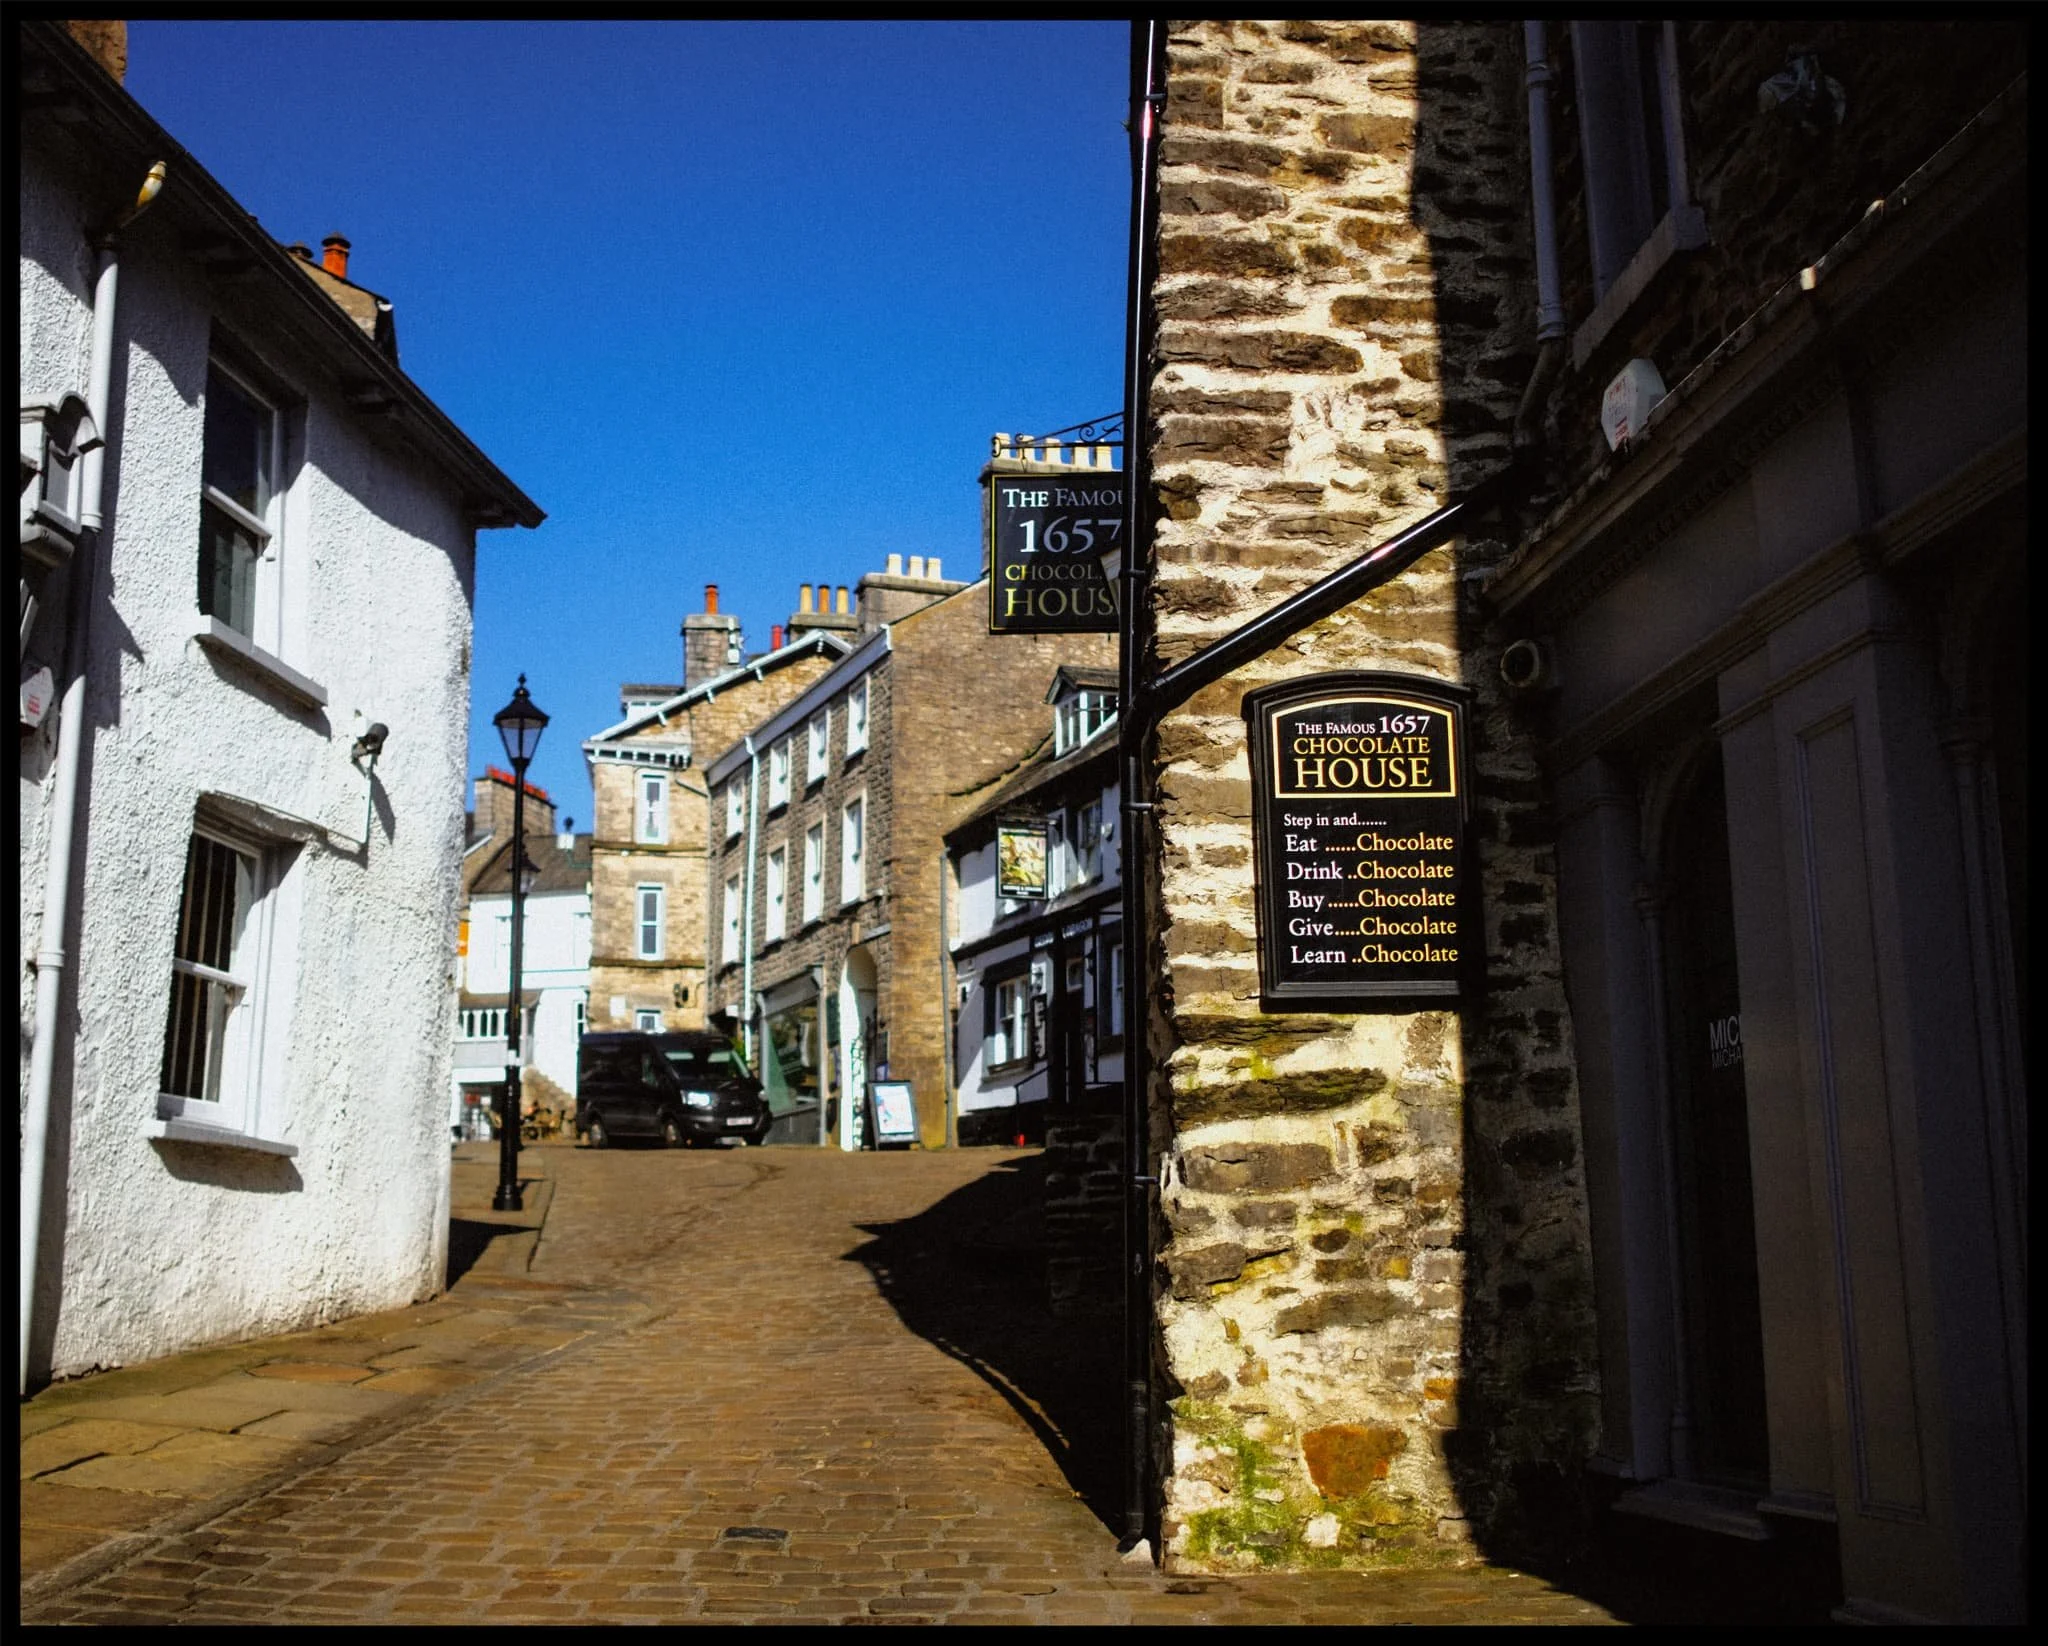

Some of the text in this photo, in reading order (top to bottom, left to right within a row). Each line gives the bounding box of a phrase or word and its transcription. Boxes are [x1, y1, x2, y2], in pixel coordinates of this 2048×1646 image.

[1002, 488, 1048, 507] THE
[1019, 516, 1122, 554] 1657
[1005, 564, 1102, 581] CHOCOL
[1295, 714, 1430, 734] THE FAMOUS 1657
[1293, 737, 1430, 754] CHOCOLATE
[1294, 757, 1432, 788] HOUSE
[1284, 814, 1312, 829] Step
[1316, 814, 1329, 826] in
[1285, 834, 1317, 852] Eat
[1286, 861, 1343, 879] Drink
[1288, 890, 1325, 912] Buy
[1291, 945, 1346, 963] Learn
